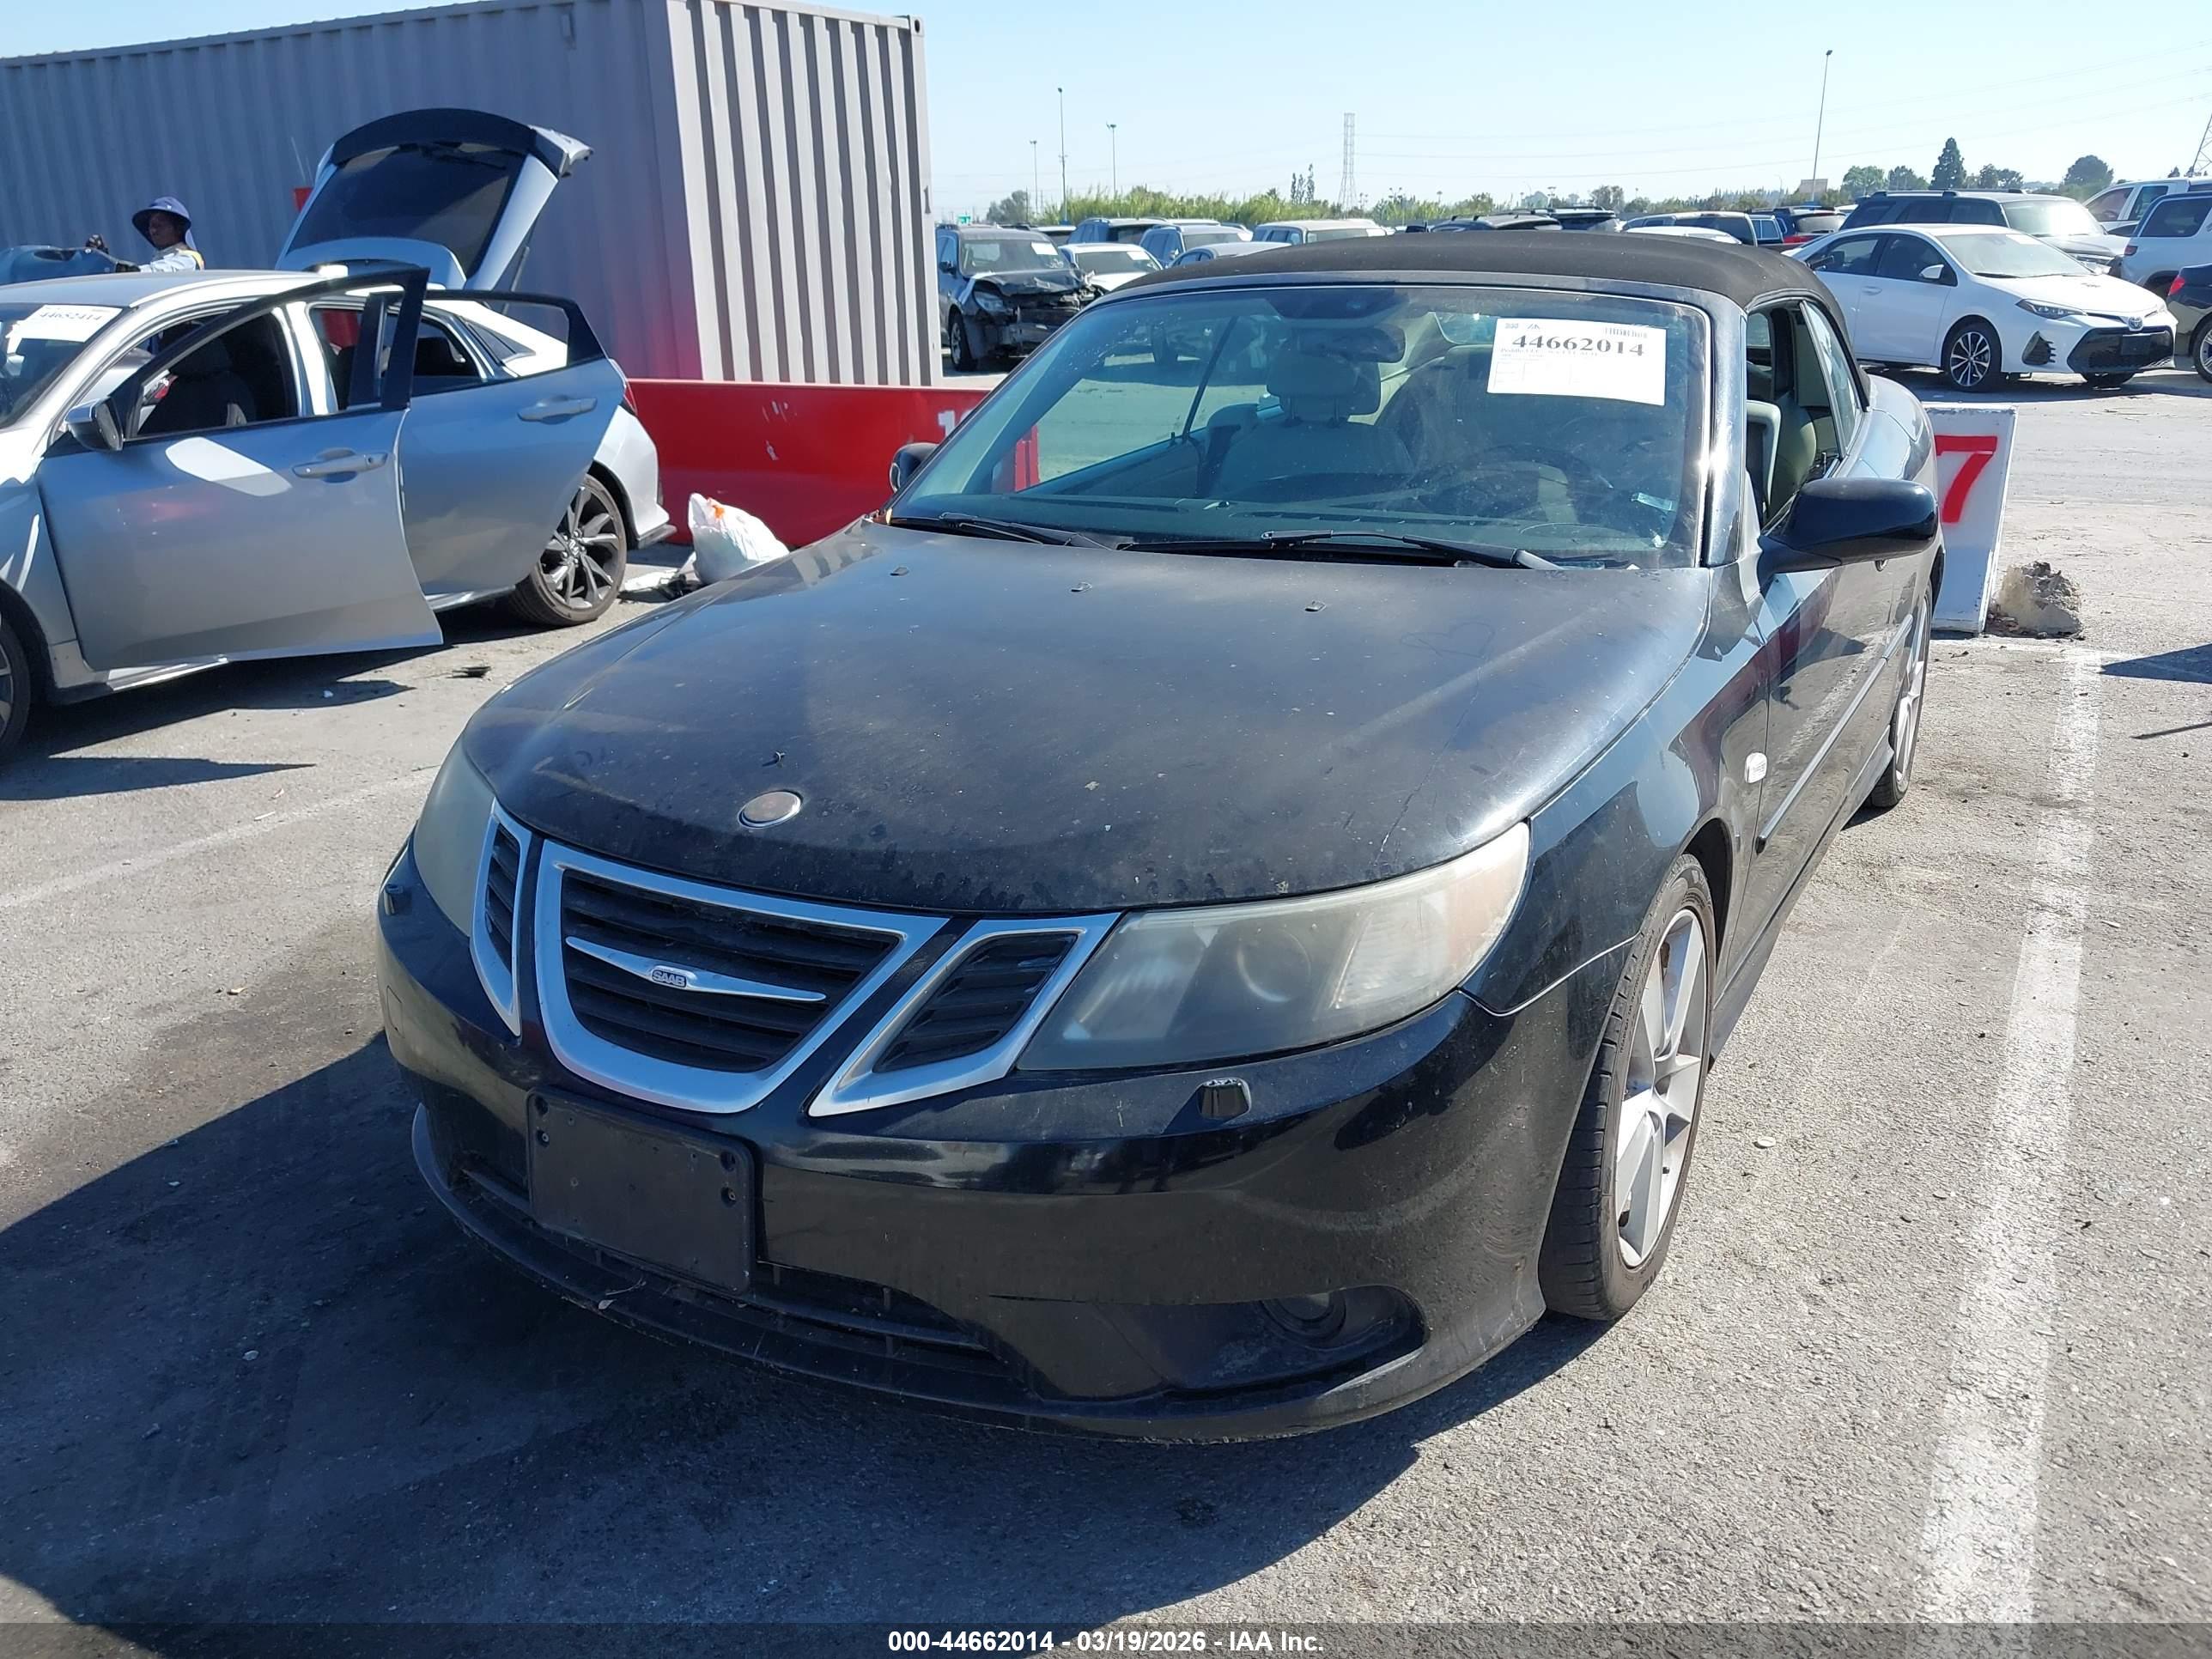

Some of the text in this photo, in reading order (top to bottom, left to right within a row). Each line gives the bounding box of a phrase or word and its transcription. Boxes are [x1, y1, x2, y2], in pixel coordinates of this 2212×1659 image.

[1511, 334, 1644, 356] 44662014
[938, 410, 974, 439] 1
[1934, 434, 1997, 523] 7
[653, 970, 686, 987] SAAB
